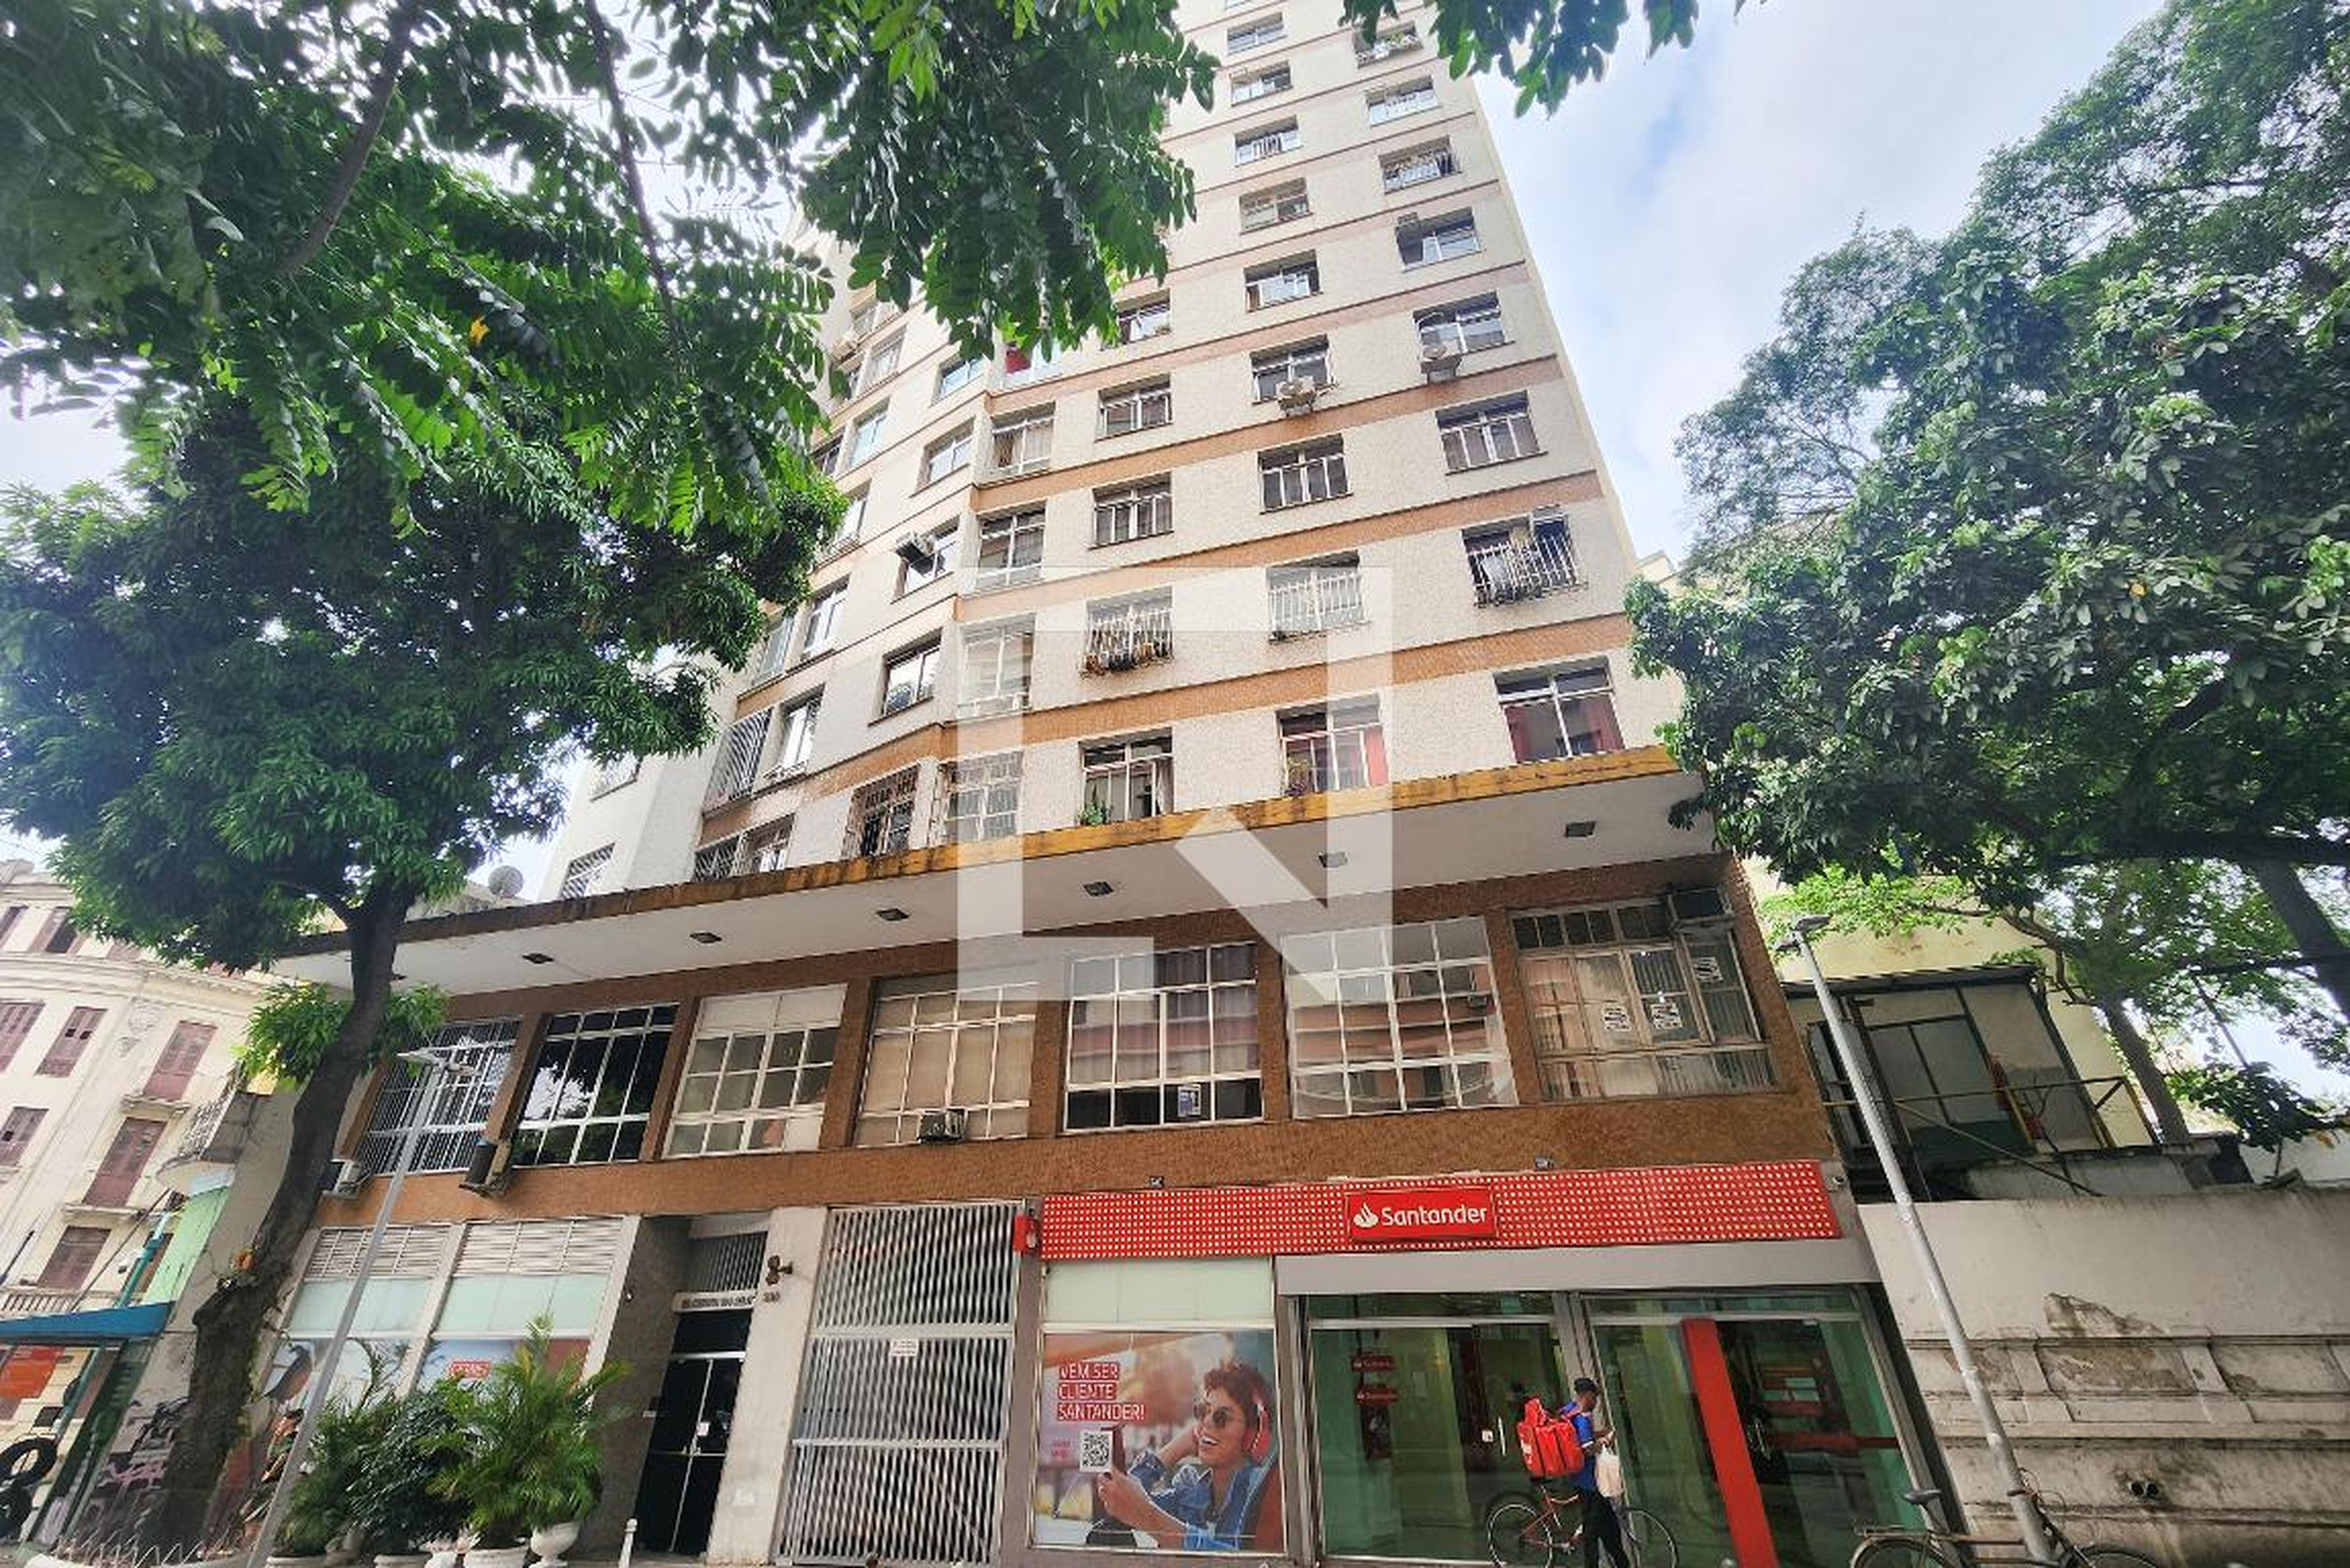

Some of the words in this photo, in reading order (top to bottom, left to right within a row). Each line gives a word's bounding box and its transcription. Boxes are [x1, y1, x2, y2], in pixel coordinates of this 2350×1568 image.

[1381, 1204, 1487, 1226] Santander
[1061, 1362, 1089, 1379] VEM
[1092, 1362, 1118, 1378] SER
[1059, 1383, 1114, 1400] CLIENTE
[1058, 1404, 1145, 1421] SANTANDER!
